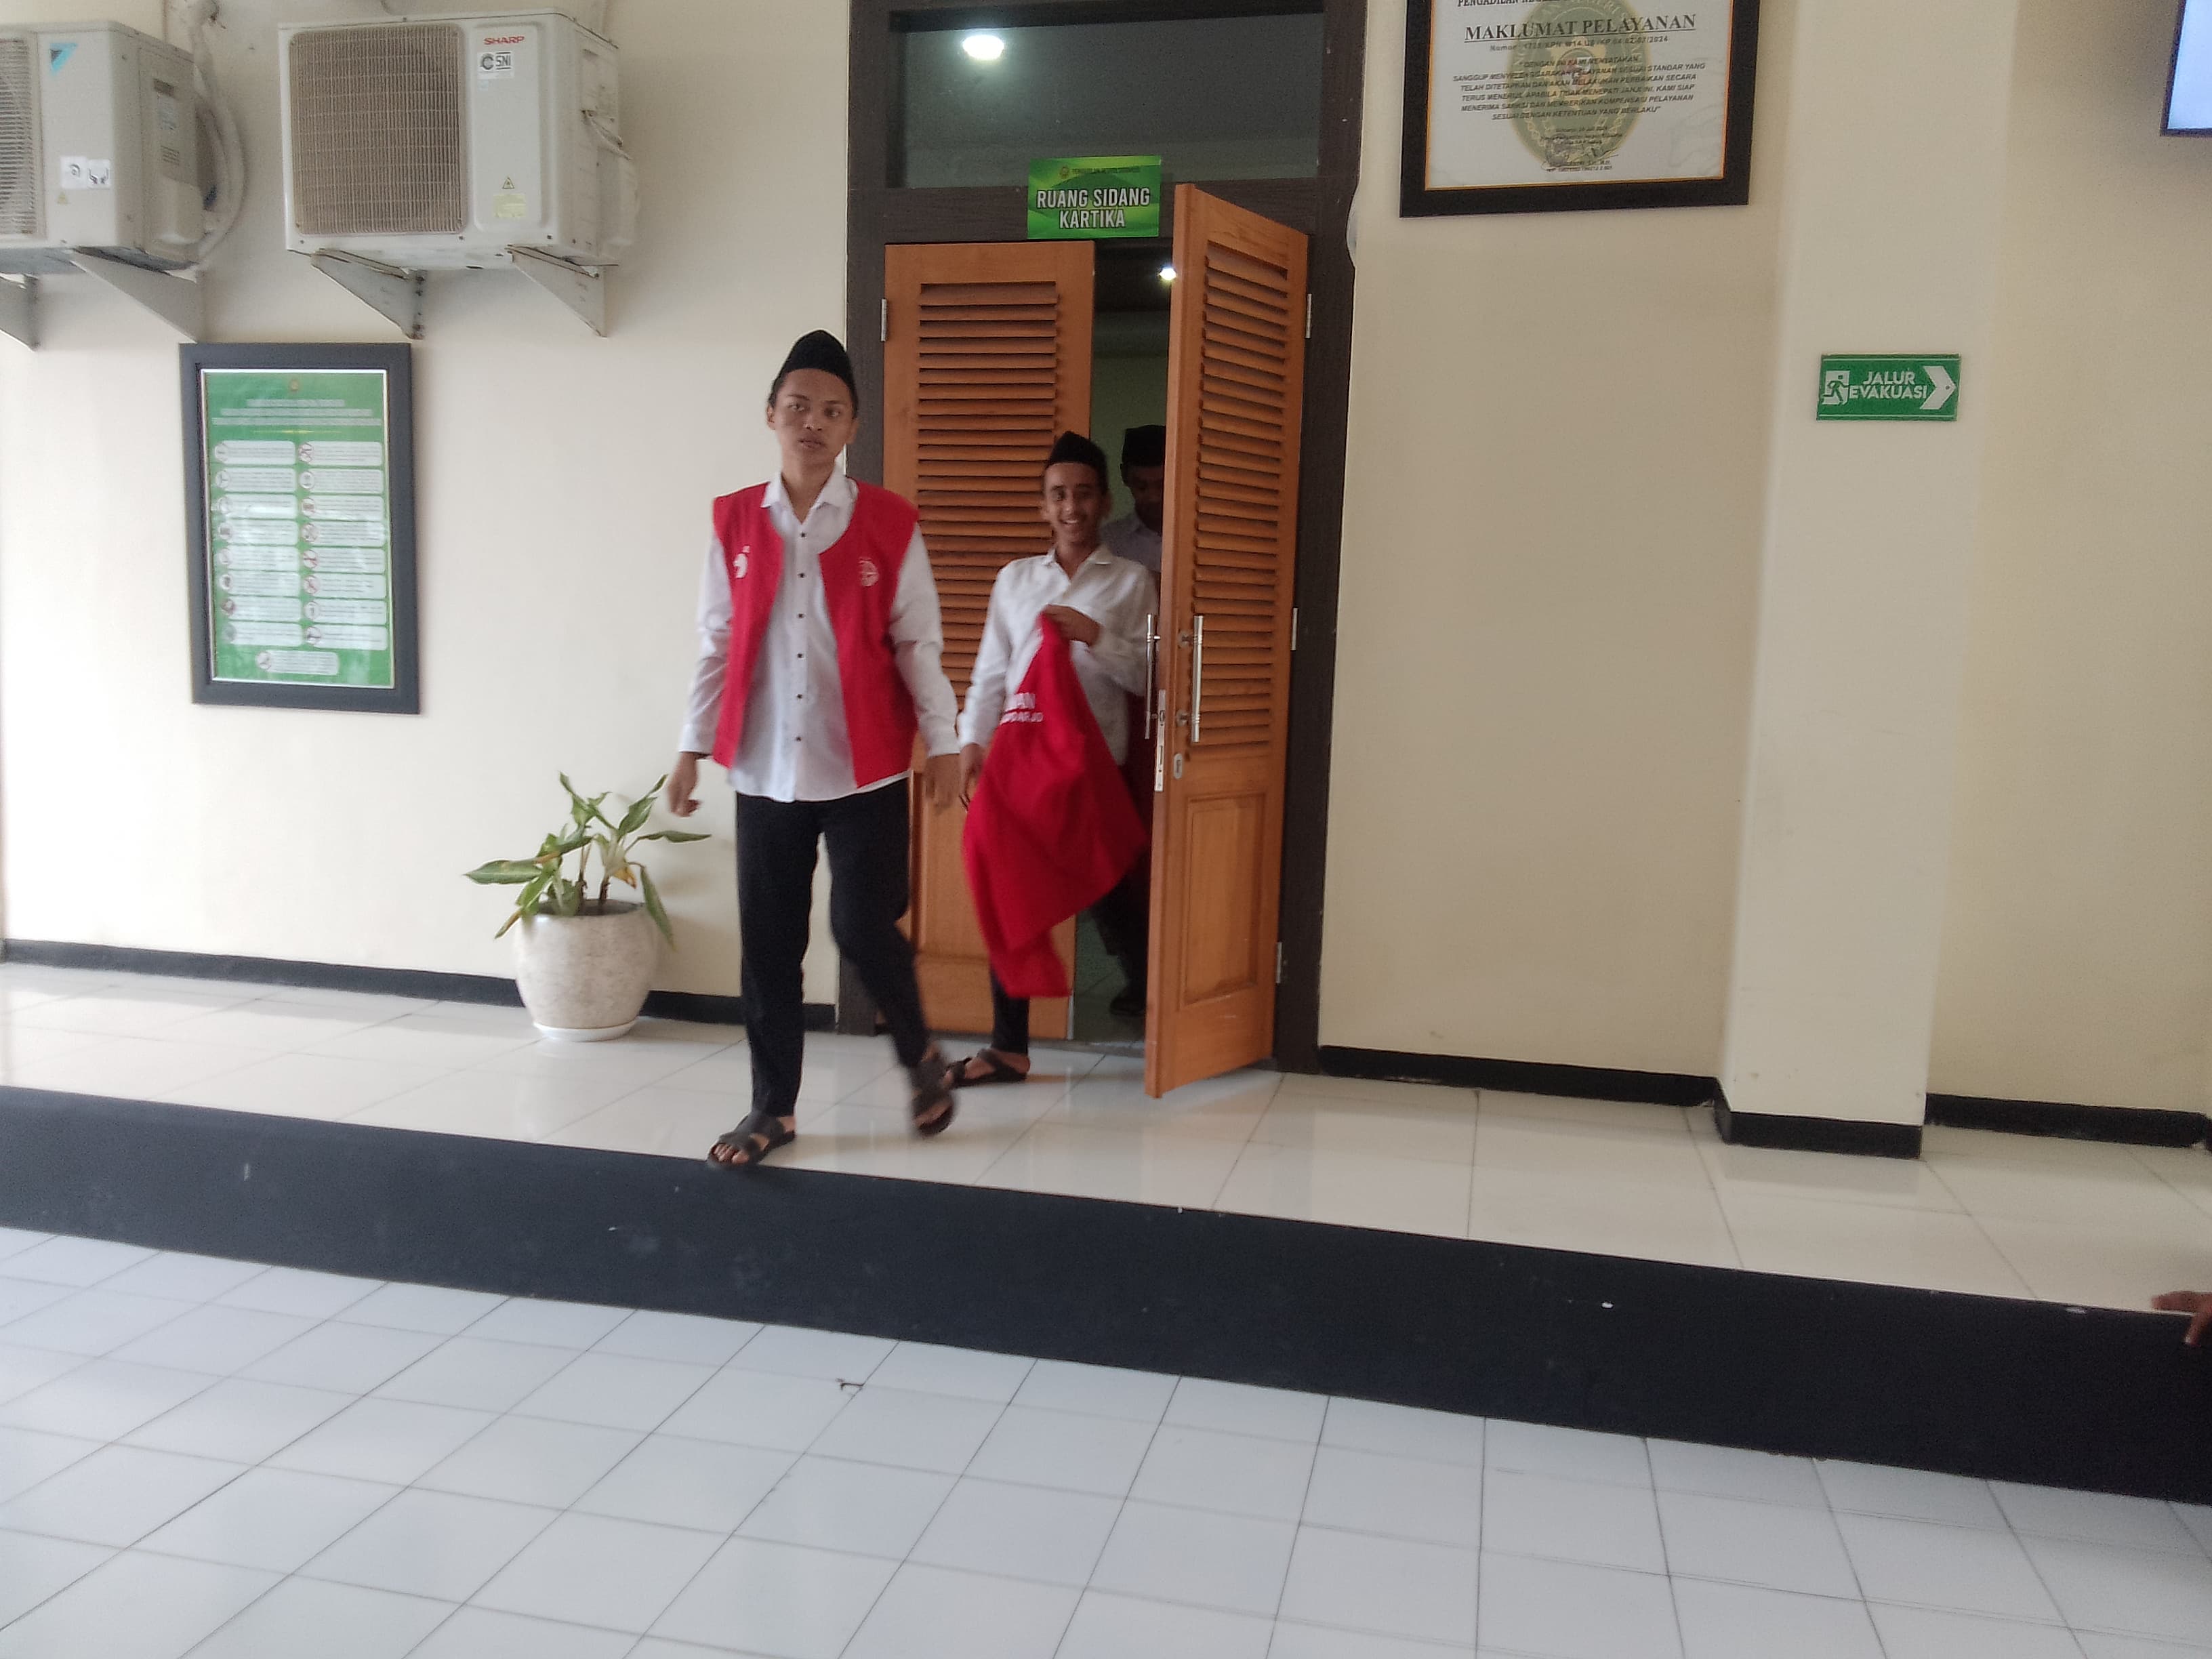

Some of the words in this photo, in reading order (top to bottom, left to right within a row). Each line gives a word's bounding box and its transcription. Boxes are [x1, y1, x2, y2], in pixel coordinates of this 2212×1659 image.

[1465, 21, 1578, 40] MAKLUMAT
[1583, 14, 1696, 33] PELAYANAN
[484, 36, 525, 45] SHARP
[495, 55, 511, 66] SNI
[1452, 73, 1490, 81] SANGGUP
[1647, 64, 1683, 72] STANDAR
[1461, 104, 1500, 112] MENERIMA
[1648, 95, 1694, 103] PELAYANAN
[1037, 189, 1088, 208] RUANG
[1093, 188, 1150, 207] SIDANG
[1059, 209, 1125, 228] KARTIKA
[1864, 371, 1915, 385] JALUR
[1849, 385, 1927, 398] EVAKUASI
